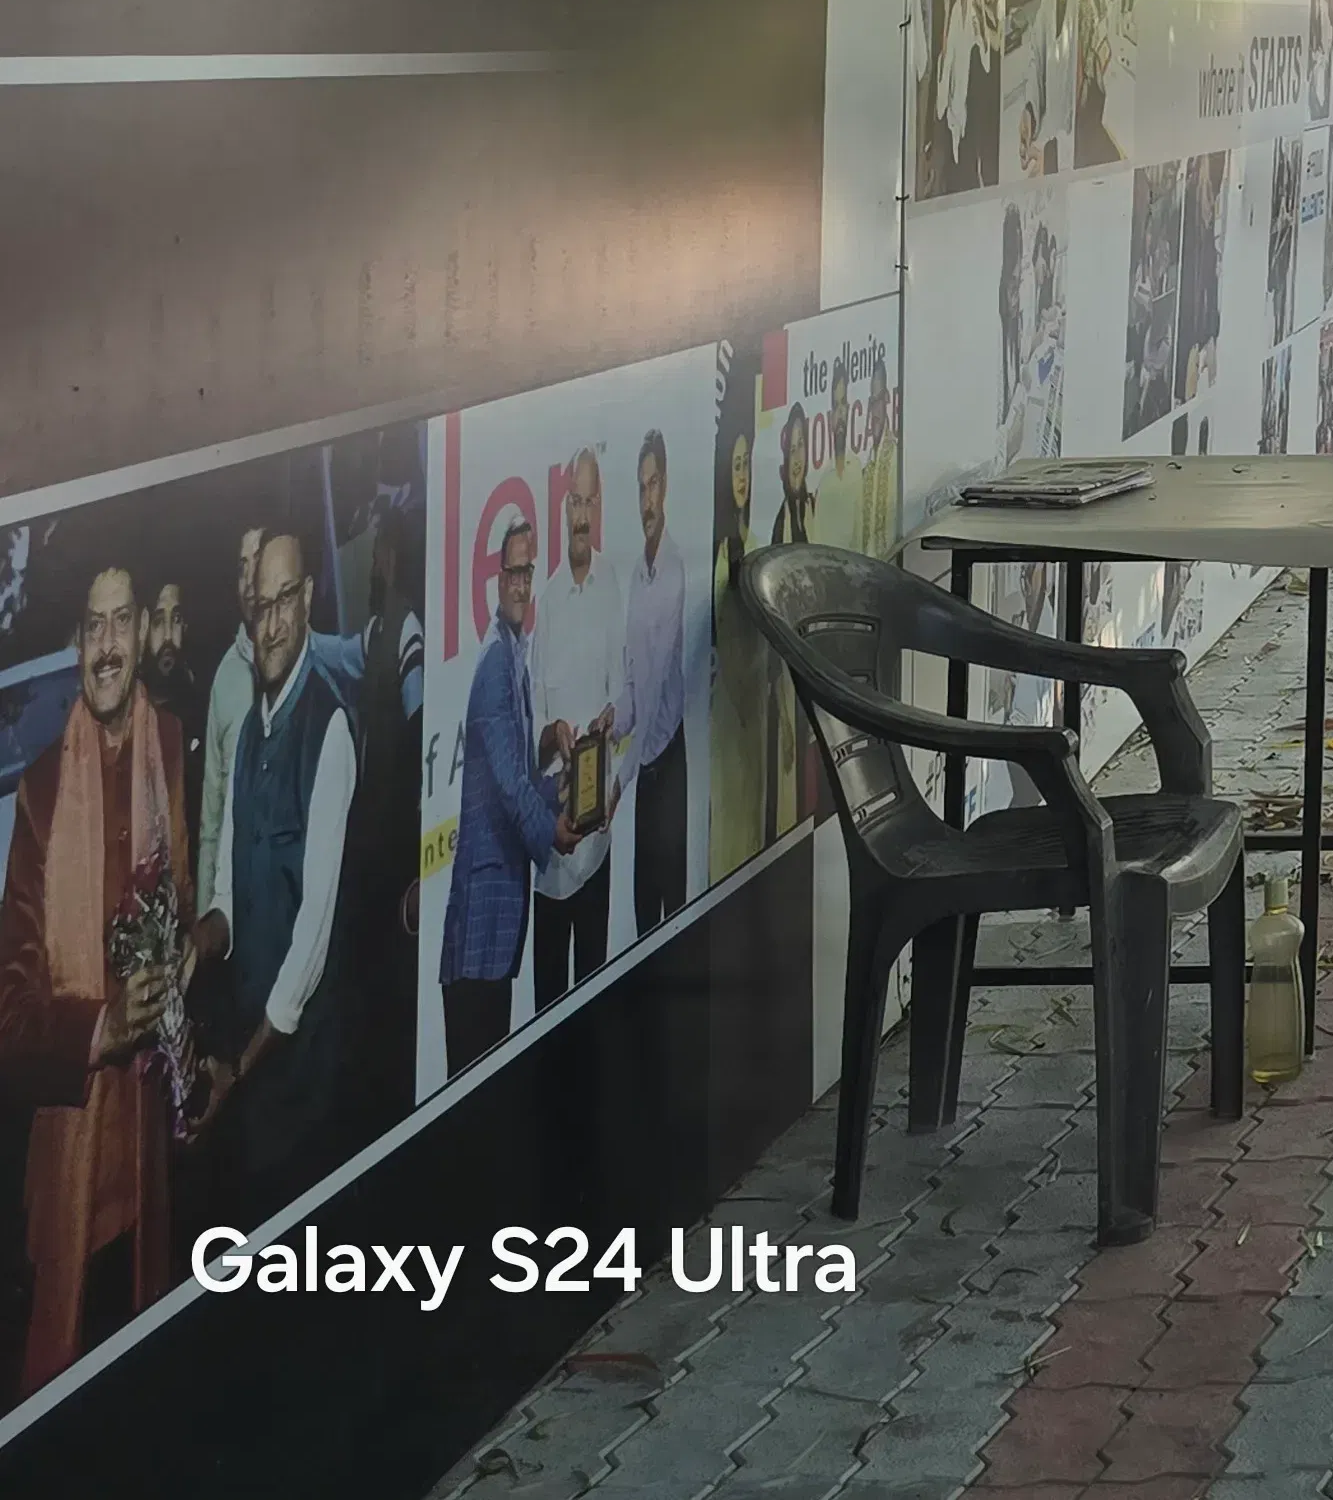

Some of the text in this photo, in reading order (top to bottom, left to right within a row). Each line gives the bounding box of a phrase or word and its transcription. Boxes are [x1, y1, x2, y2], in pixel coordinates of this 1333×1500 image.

[1198, 51, 1235, 119] where
[1248, 34, 1302, 112] STARTS
[803, 350, 828, 398] the
